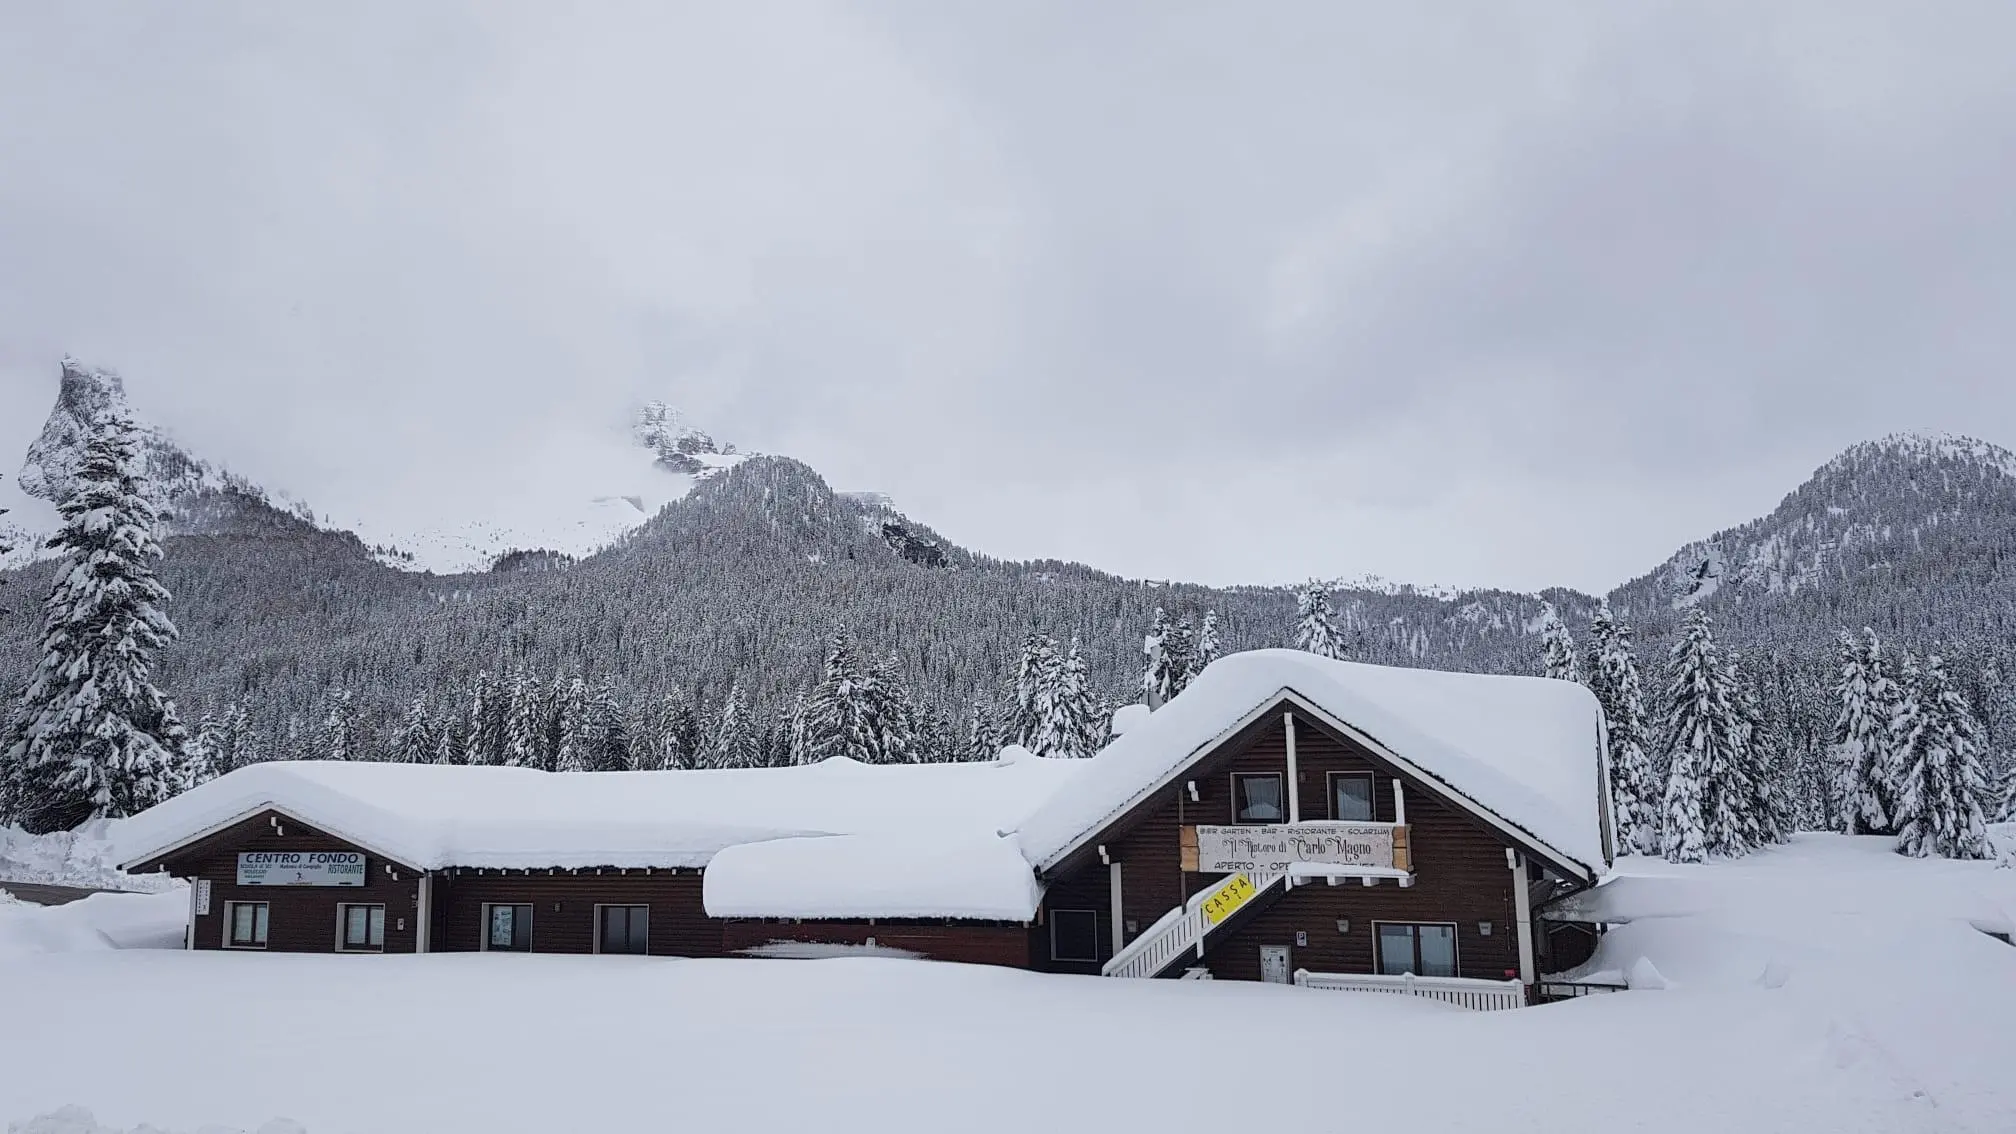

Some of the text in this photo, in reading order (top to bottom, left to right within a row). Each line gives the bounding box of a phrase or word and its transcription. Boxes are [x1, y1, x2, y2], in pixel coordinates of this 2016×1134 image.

[1220, 827, 1252, 835] GARTEN
[1347, 828, 1390, 836] SOLARIUM
[1278, 840, 1287, 853] di
[1288, 835, 1326, 862] Carlo
[1325, 835, 1371, 862] Magno
[246, 853, 359, 864] CENTRO FONDO
[327, 863, 363, 875] RISTORANTE
[1214, 861, 1255, 871] APERTO
[1205, 878, 1248, 914] CASSA
